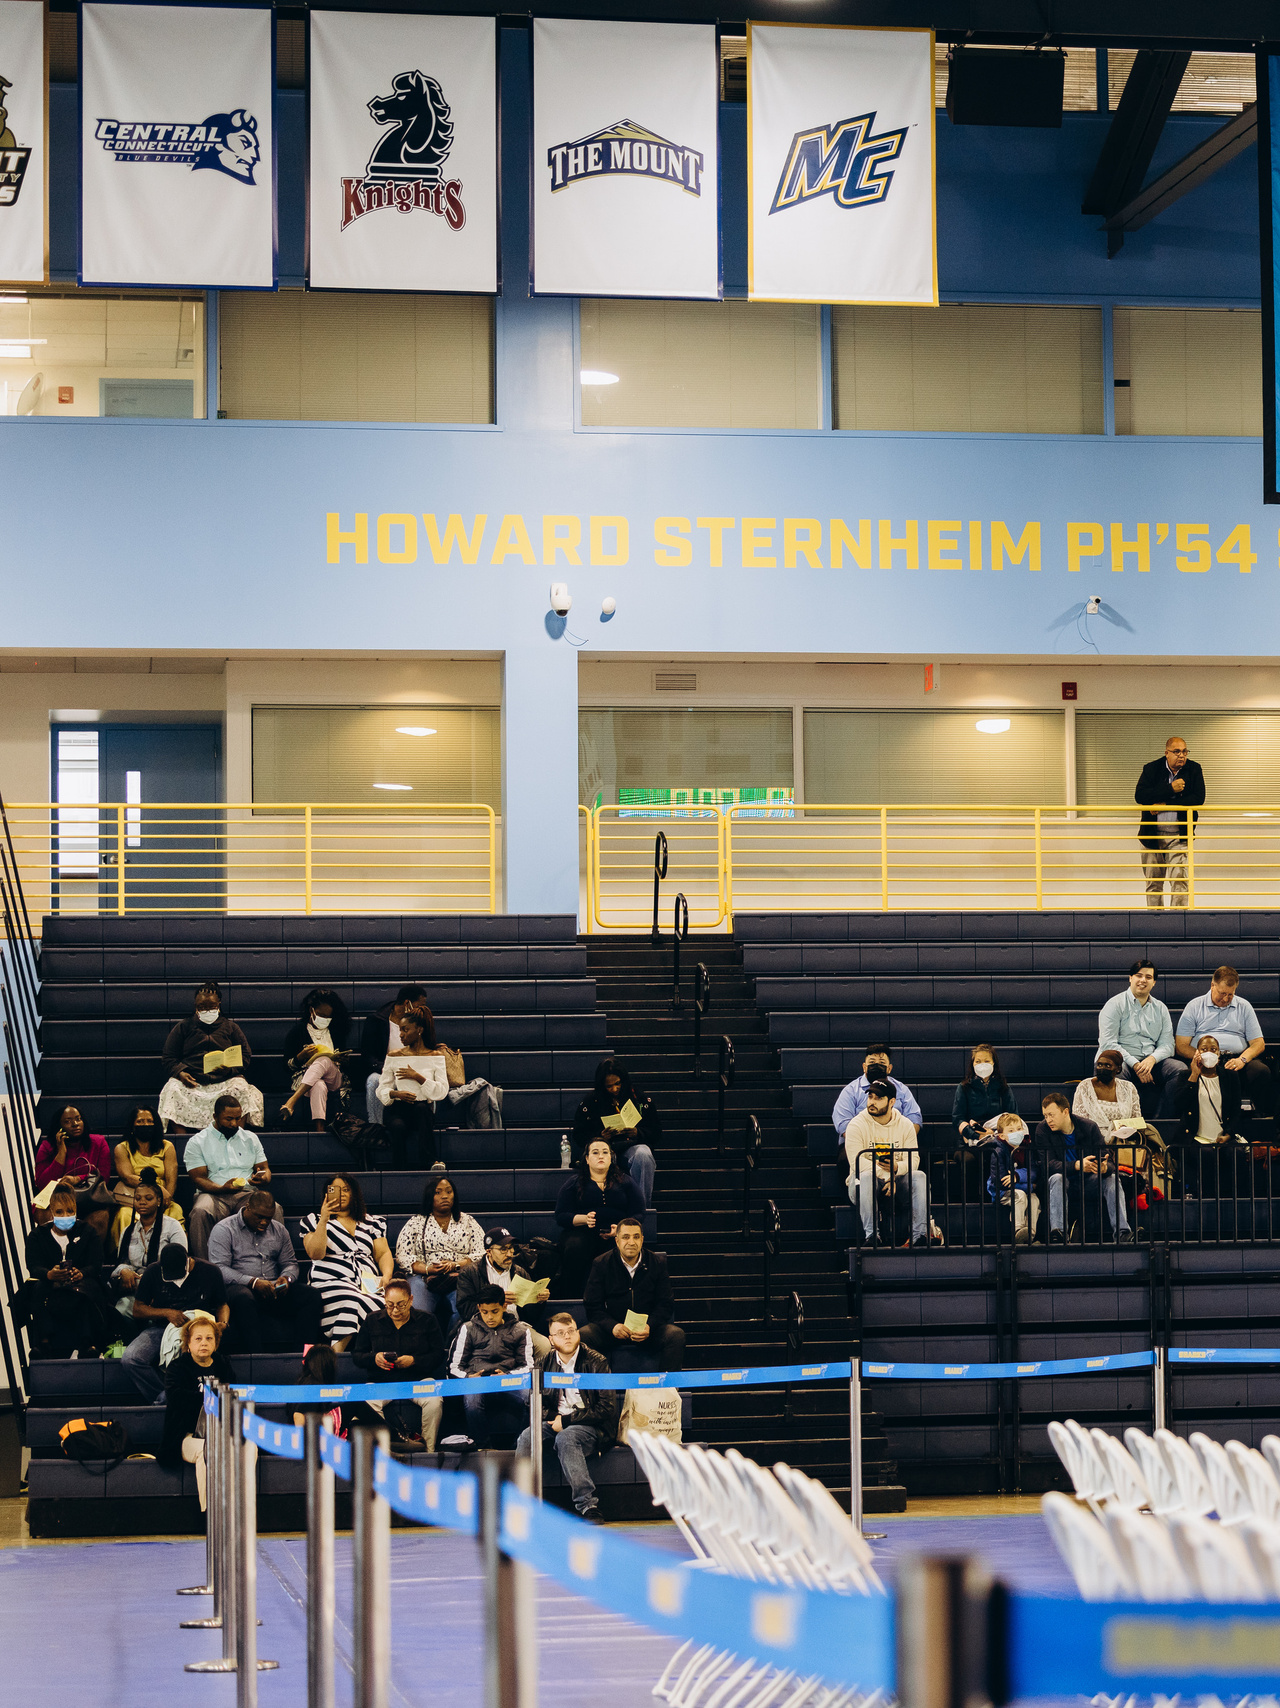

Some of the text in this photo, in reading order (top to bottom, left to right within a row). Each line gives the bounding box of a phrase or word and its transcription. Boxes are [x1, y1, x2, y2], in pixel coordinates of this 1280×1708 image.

[96, 121, 222, 142] CENTRAL
[104, 140, 214, 152] CONNECTICUT
[551, 140, 702, 190] THE MOUNT
[769, 112, 909, 215] MC
[325, 512, 630, 566] HOWARD
[654, 516, 1042, 571] STERNHEIM
